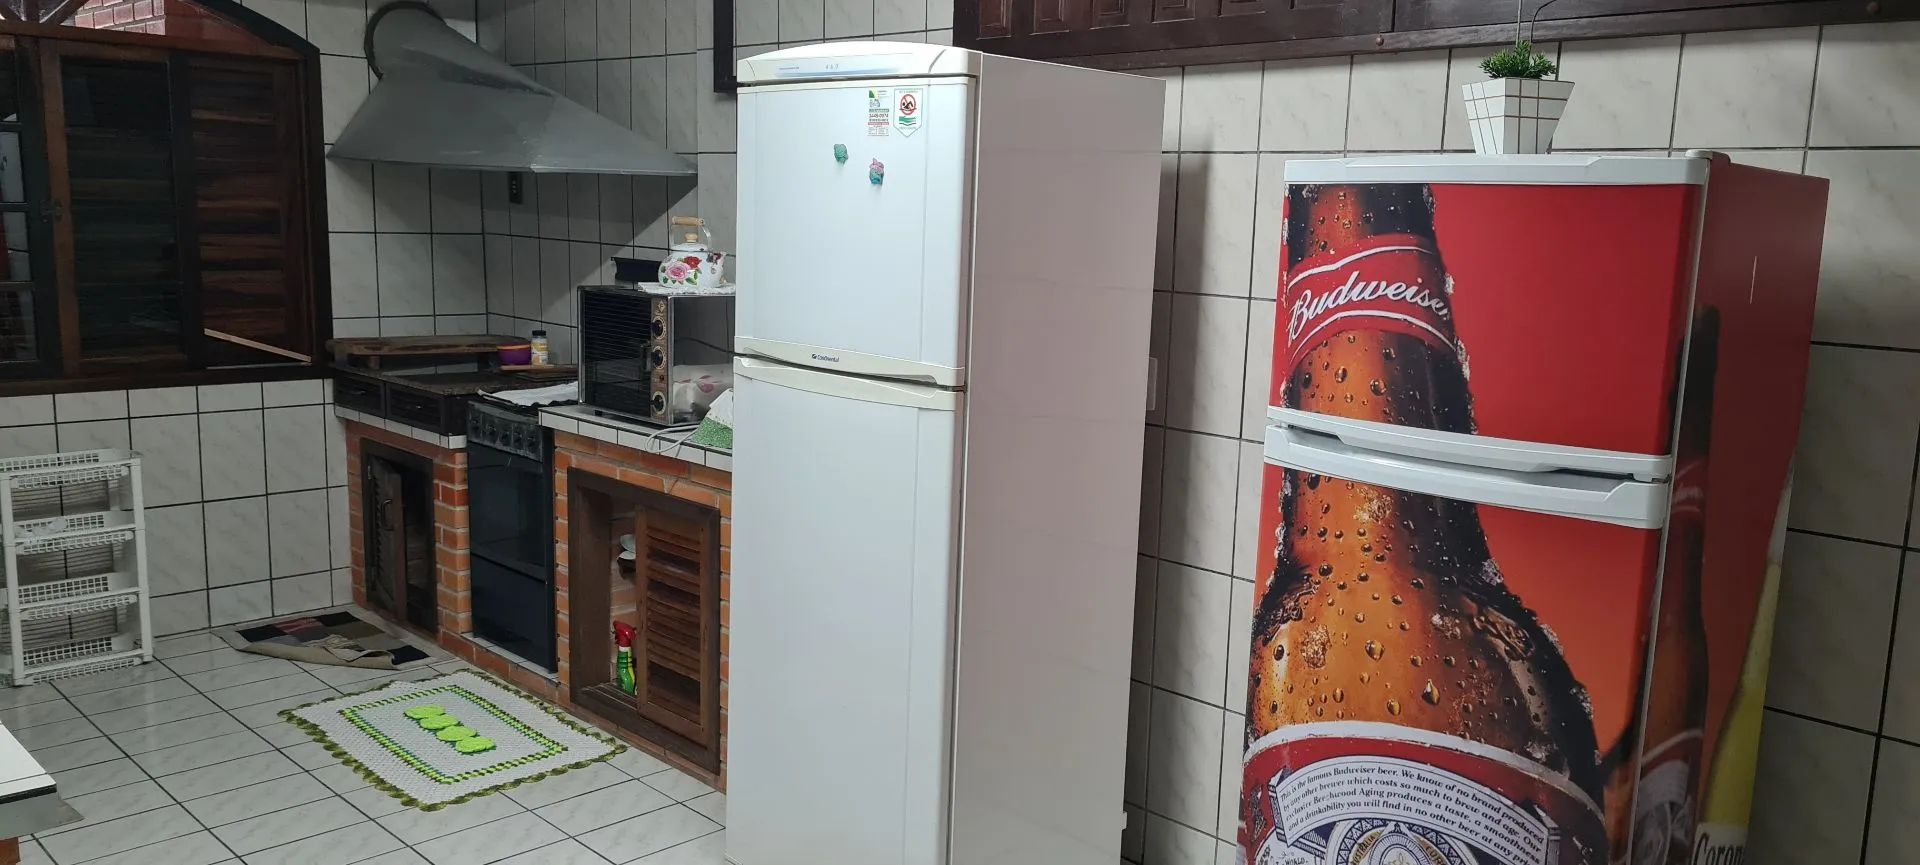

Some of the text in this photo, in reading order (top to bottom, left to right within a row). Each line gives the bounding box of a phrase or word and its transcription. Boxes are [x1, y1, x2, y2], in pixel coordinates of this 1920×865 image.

[1281, 792, 1292, 802] This
[1298, 780, 1306, 790] the
[1307, 771, 1332, 784] famous
[1333, 766, 1375, 776] Budweiser
[1378, 766, 1398, 776] beer.
[1402, 770, 1415, 780] We
[1416, 773, 1443, 787] know
[1457, 787, 1469, 798] no
[1471, 793, 1501, 813] brand
[1501, 812, 1544, 844] produced
[1283, 804, 1290, 812] by
[1301, 786, 1318, 798] other
[1320, 780, 1344, 791] brewer
[1347, 777, 1372, 785] which
[1375, 779, 1397, 787] costs
[1413, 785, 1440, 798] much
[1443, 793, 1452, 802] to
[1455, 796, 1480, 813] brew
[1481, 811, 1501, 825] and
[1502, 823, 1520, 839] age.
[1524, 835, 1541, 853] Our
[1286, 802, 1312, 821] exclusive
[1313, 788, 1357, 804] Beehwood
[1359, 788, 1384, 797] Aging
[1386, 791, 1432, 806] produces
[1444, 804, 1472, 823] taste,
[1483, 824, 1540, 864] smoothness
[1288, 820, 1301, 831] and
[1304, 801, 1346, 820] drinkability
[1346, 801, 1361, 810] you
[1382, 800, 1400, 810] find
[1403, 804, 1412, 812] in
[1415, 808, 1428, 817] no
[1430, 812, 1456, 825] other
[1458, 822, 1480, 837] beer
[1482, 835, 1492, 844] at
[1494, 840, 1513, 857] any
